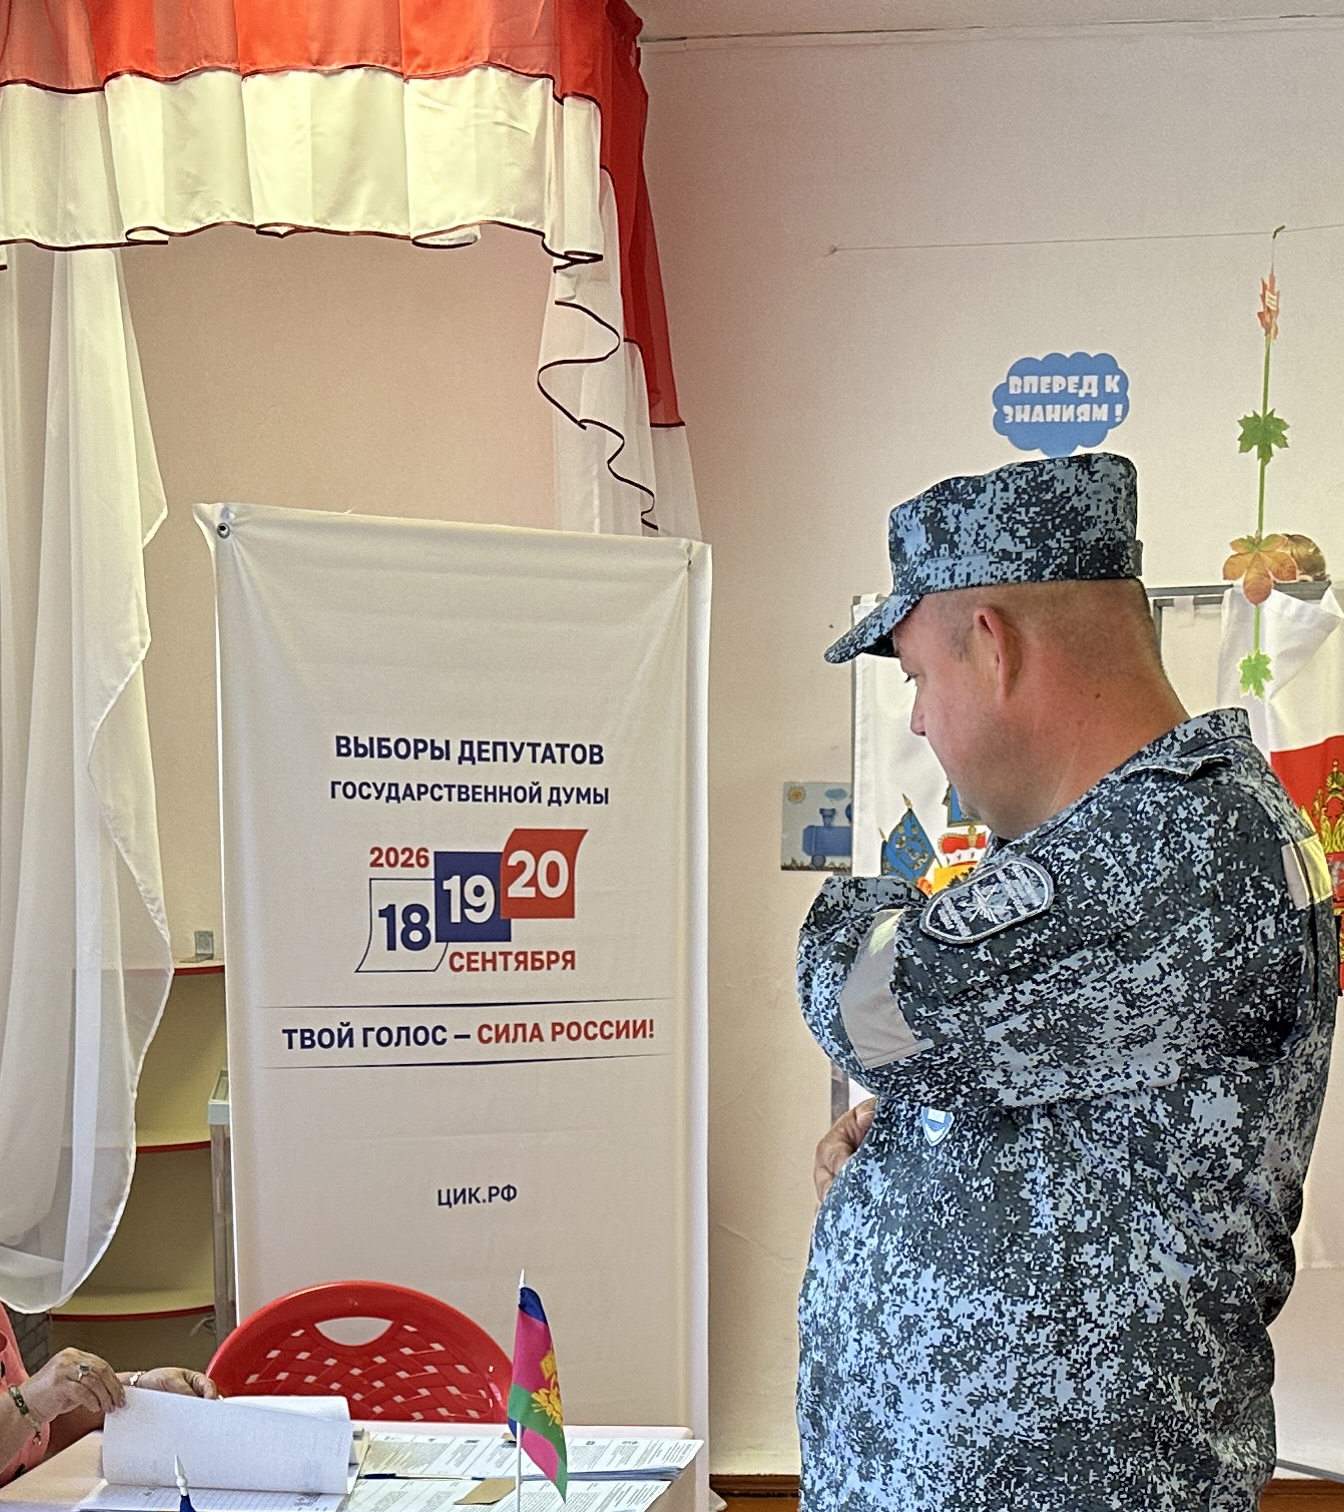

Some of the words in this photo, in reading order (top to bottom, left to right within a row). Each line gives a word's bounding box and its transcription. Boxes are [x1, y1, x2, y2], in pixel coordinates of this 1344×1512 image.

[1009, 375, 1098, 398] ВПЕРЕД
[1105, 375, 1120, 393] К
[1003, 404, 1108, 424] ЗНАНИЯМ
[335, 736, 452, 762] ВЫБОРЫ
[458, 738, 605, 768] ДЕПУТАТОВ
[330, 780, 543, 807] ГОСУДАРСТВЕННОЙ
[548, 785, 610, 810] ДУМЫ
[369, 845, 430, 870] 2026
[378, 904, 432, 952] 18
[443, 875, 497, 924] 19
[507, 849, 569, 898] 20
[448, 950, 577, 973] СЕНТЯБРЯ
[282, 1021, 354, 1050] ТВОЙ
[362, 1024, 448, 1049] ГОЛОС
[478, 1022, 545, 1046] СИЛА
[551, 1018, 656, 1043] РОССИИ!
[436, 1183, 517, 1211] ЦИК.РФ
